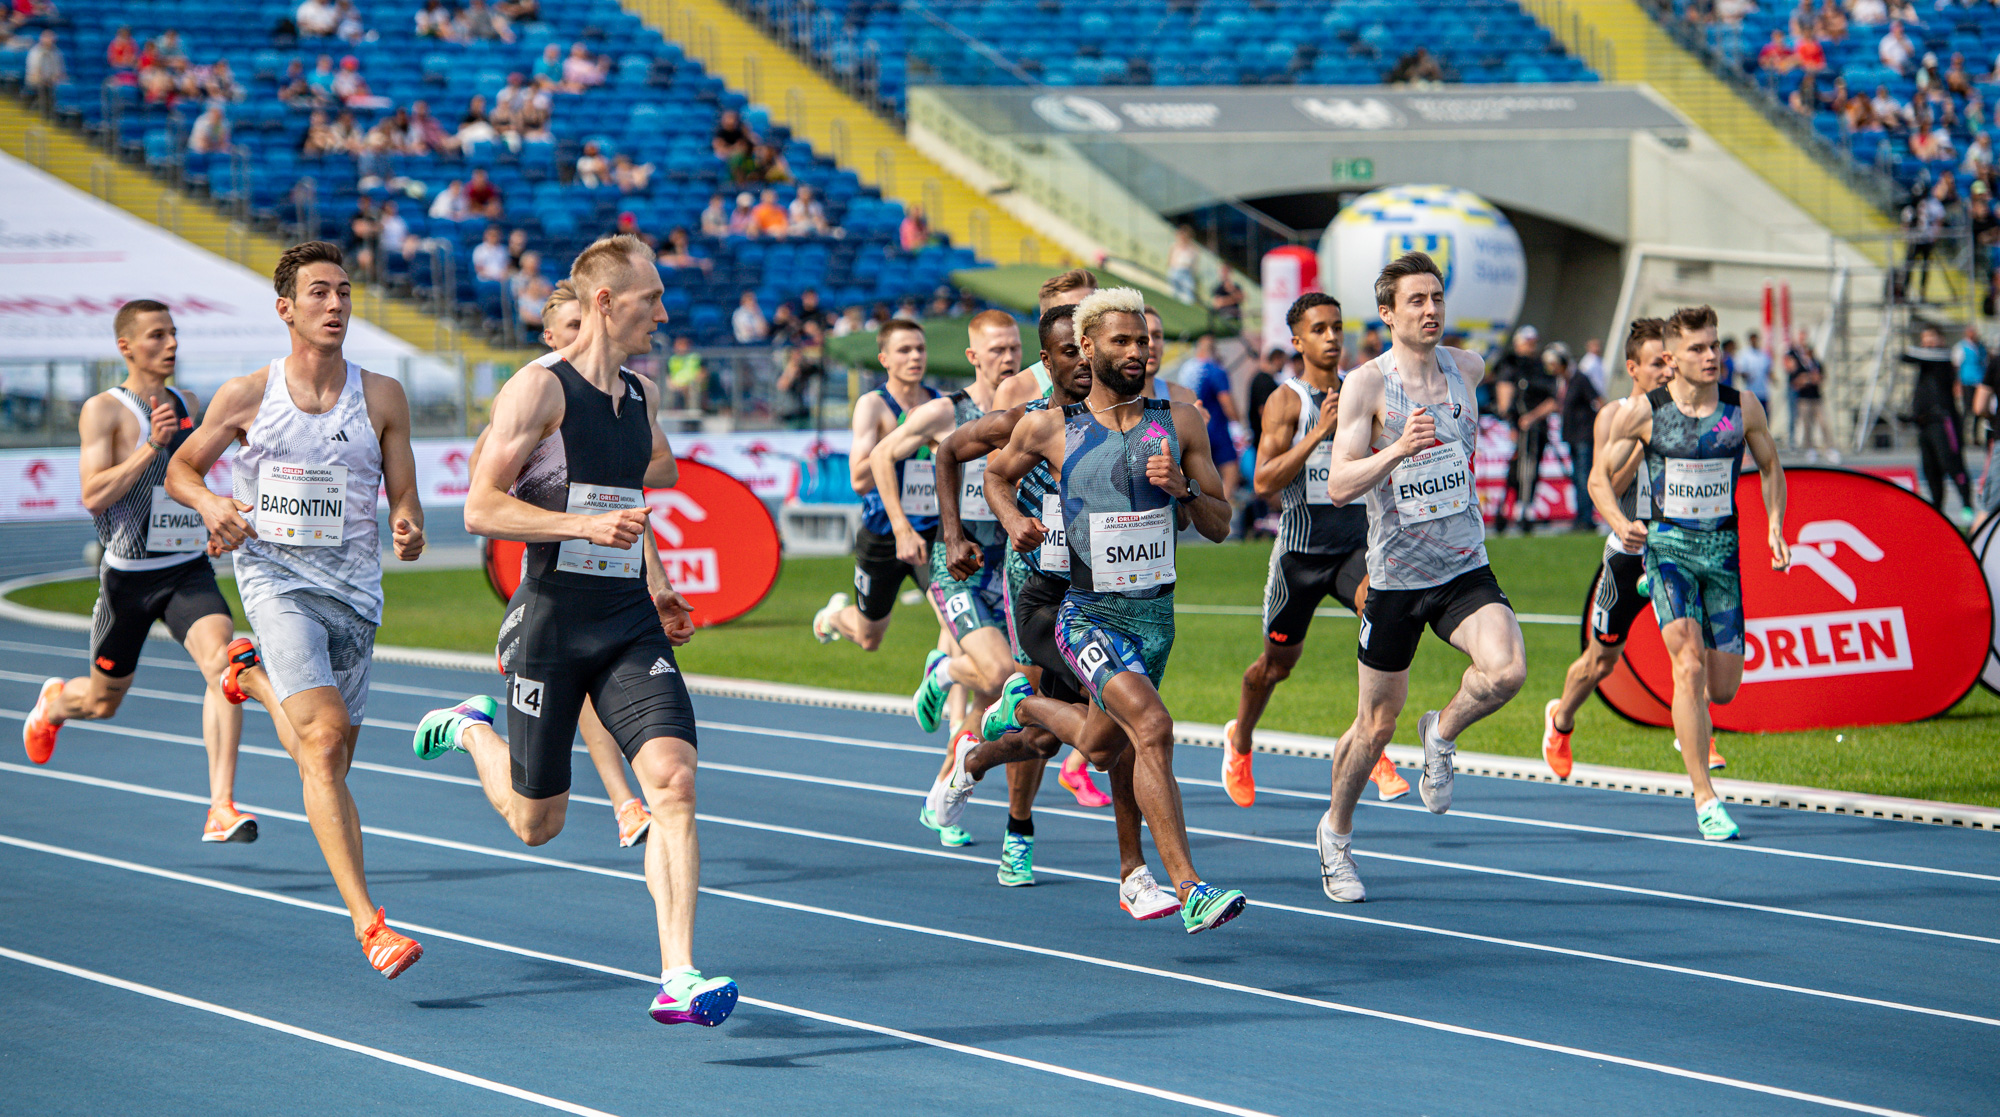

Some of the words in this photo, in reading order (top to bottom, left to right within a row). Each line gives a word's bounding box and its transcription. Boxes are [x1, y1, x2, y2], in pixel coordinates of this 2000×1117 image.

[283, 467, 303, 475] ORLEN
[1399, 470, 1466, 500] ENGLISH
[1668, 481, 1730, 498] SIERADZKI
[261, 493, 342, 517] BARONTINI
[583, 500, 608, 508] JANUSZA
[587, 492, 598, 501] 69.
[600, 494, 619, 502] ORLEN
[1105, 516, 1116, 524] 69.
[1106, 540, 1166, 563] SMAILI
[951, 596, 963, 613] 6
[1596, 611, 1603, 628] 1
[1744, 618, 1898, 672] ORLEN
[1079, 646, 1104, 673] 10
[649, 666, 676, 676] adidas
[515, 683, 541, 711] 14
